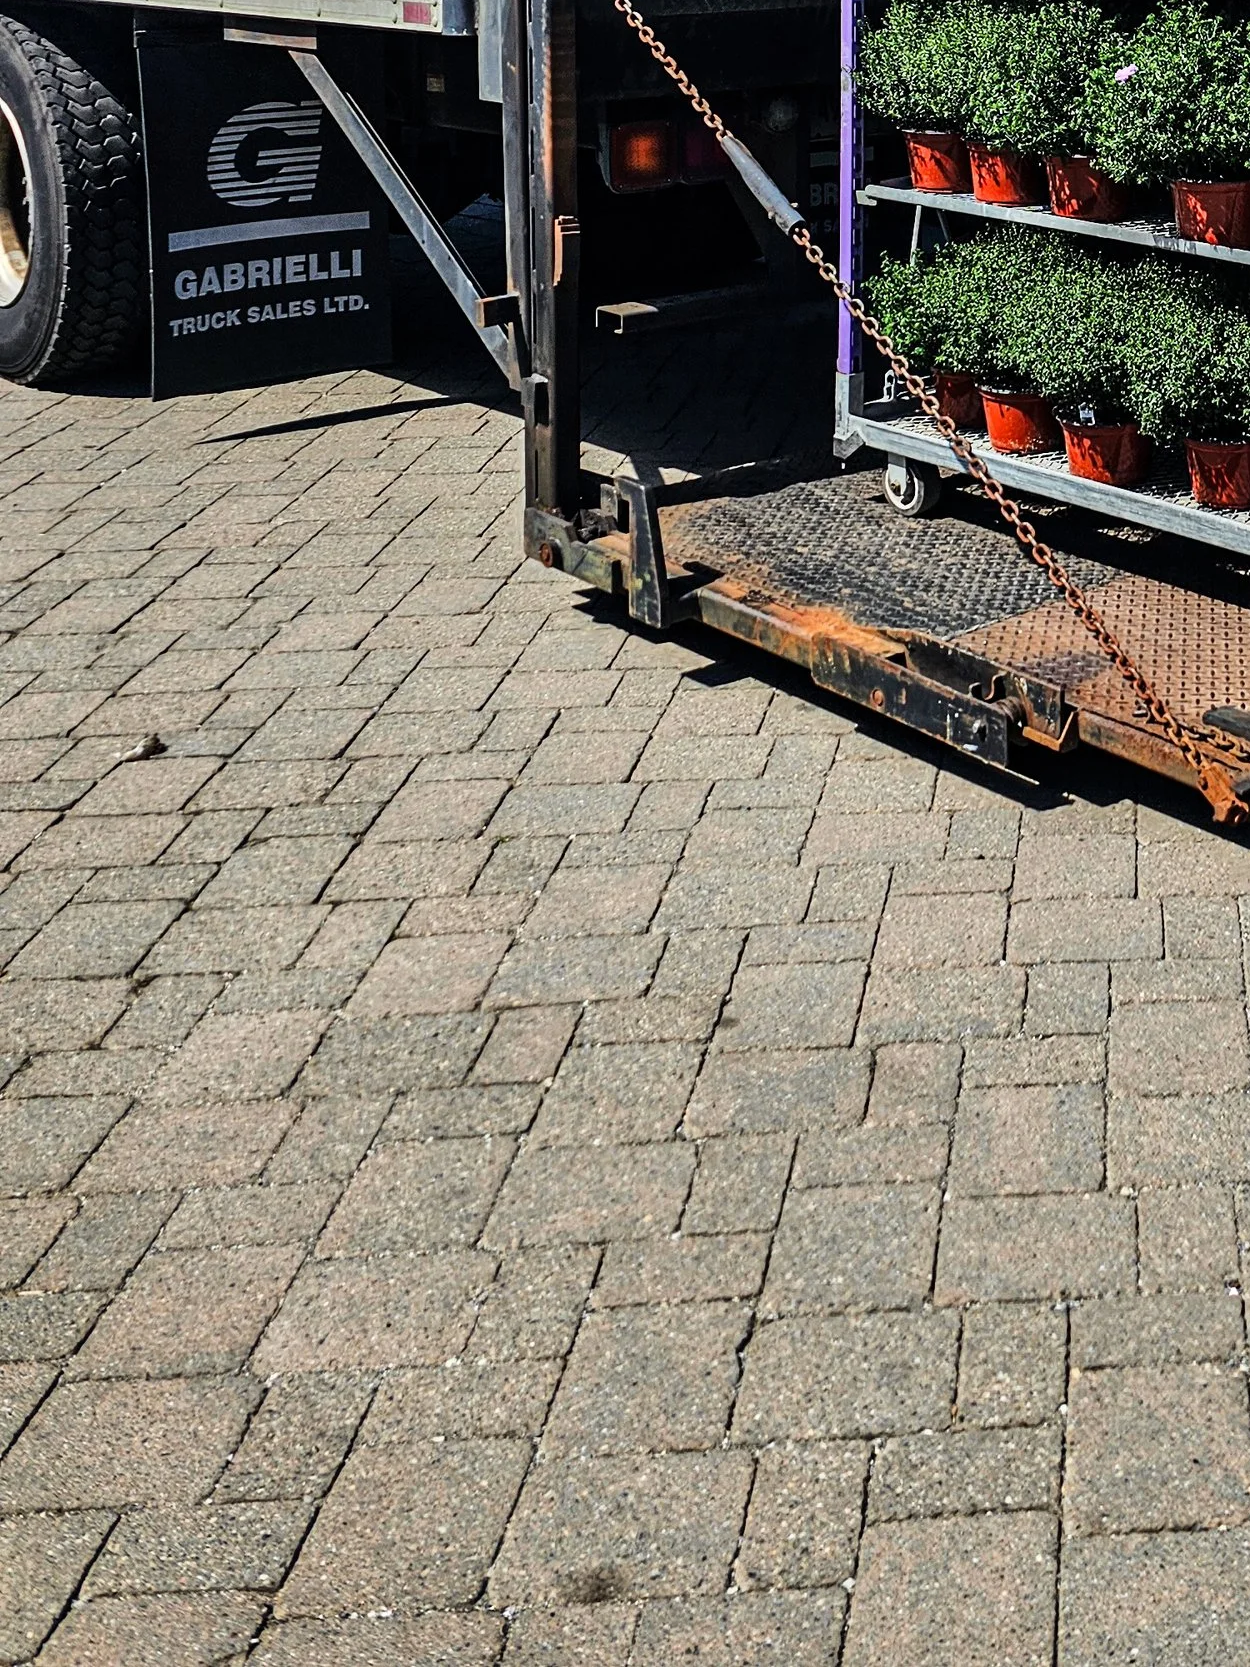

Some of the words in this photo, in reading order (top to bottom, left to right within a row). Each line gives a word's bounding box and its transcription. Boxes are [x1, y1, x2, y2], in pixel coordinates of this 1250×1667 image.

[206, 100, 323, 207] G
[174, 249, 362, 300] GABRIELLI
[169, 308, 242, 337] TRUCK
[246, 299, 317, 323] SALES
[323, 294, 370, 313] LTD.
